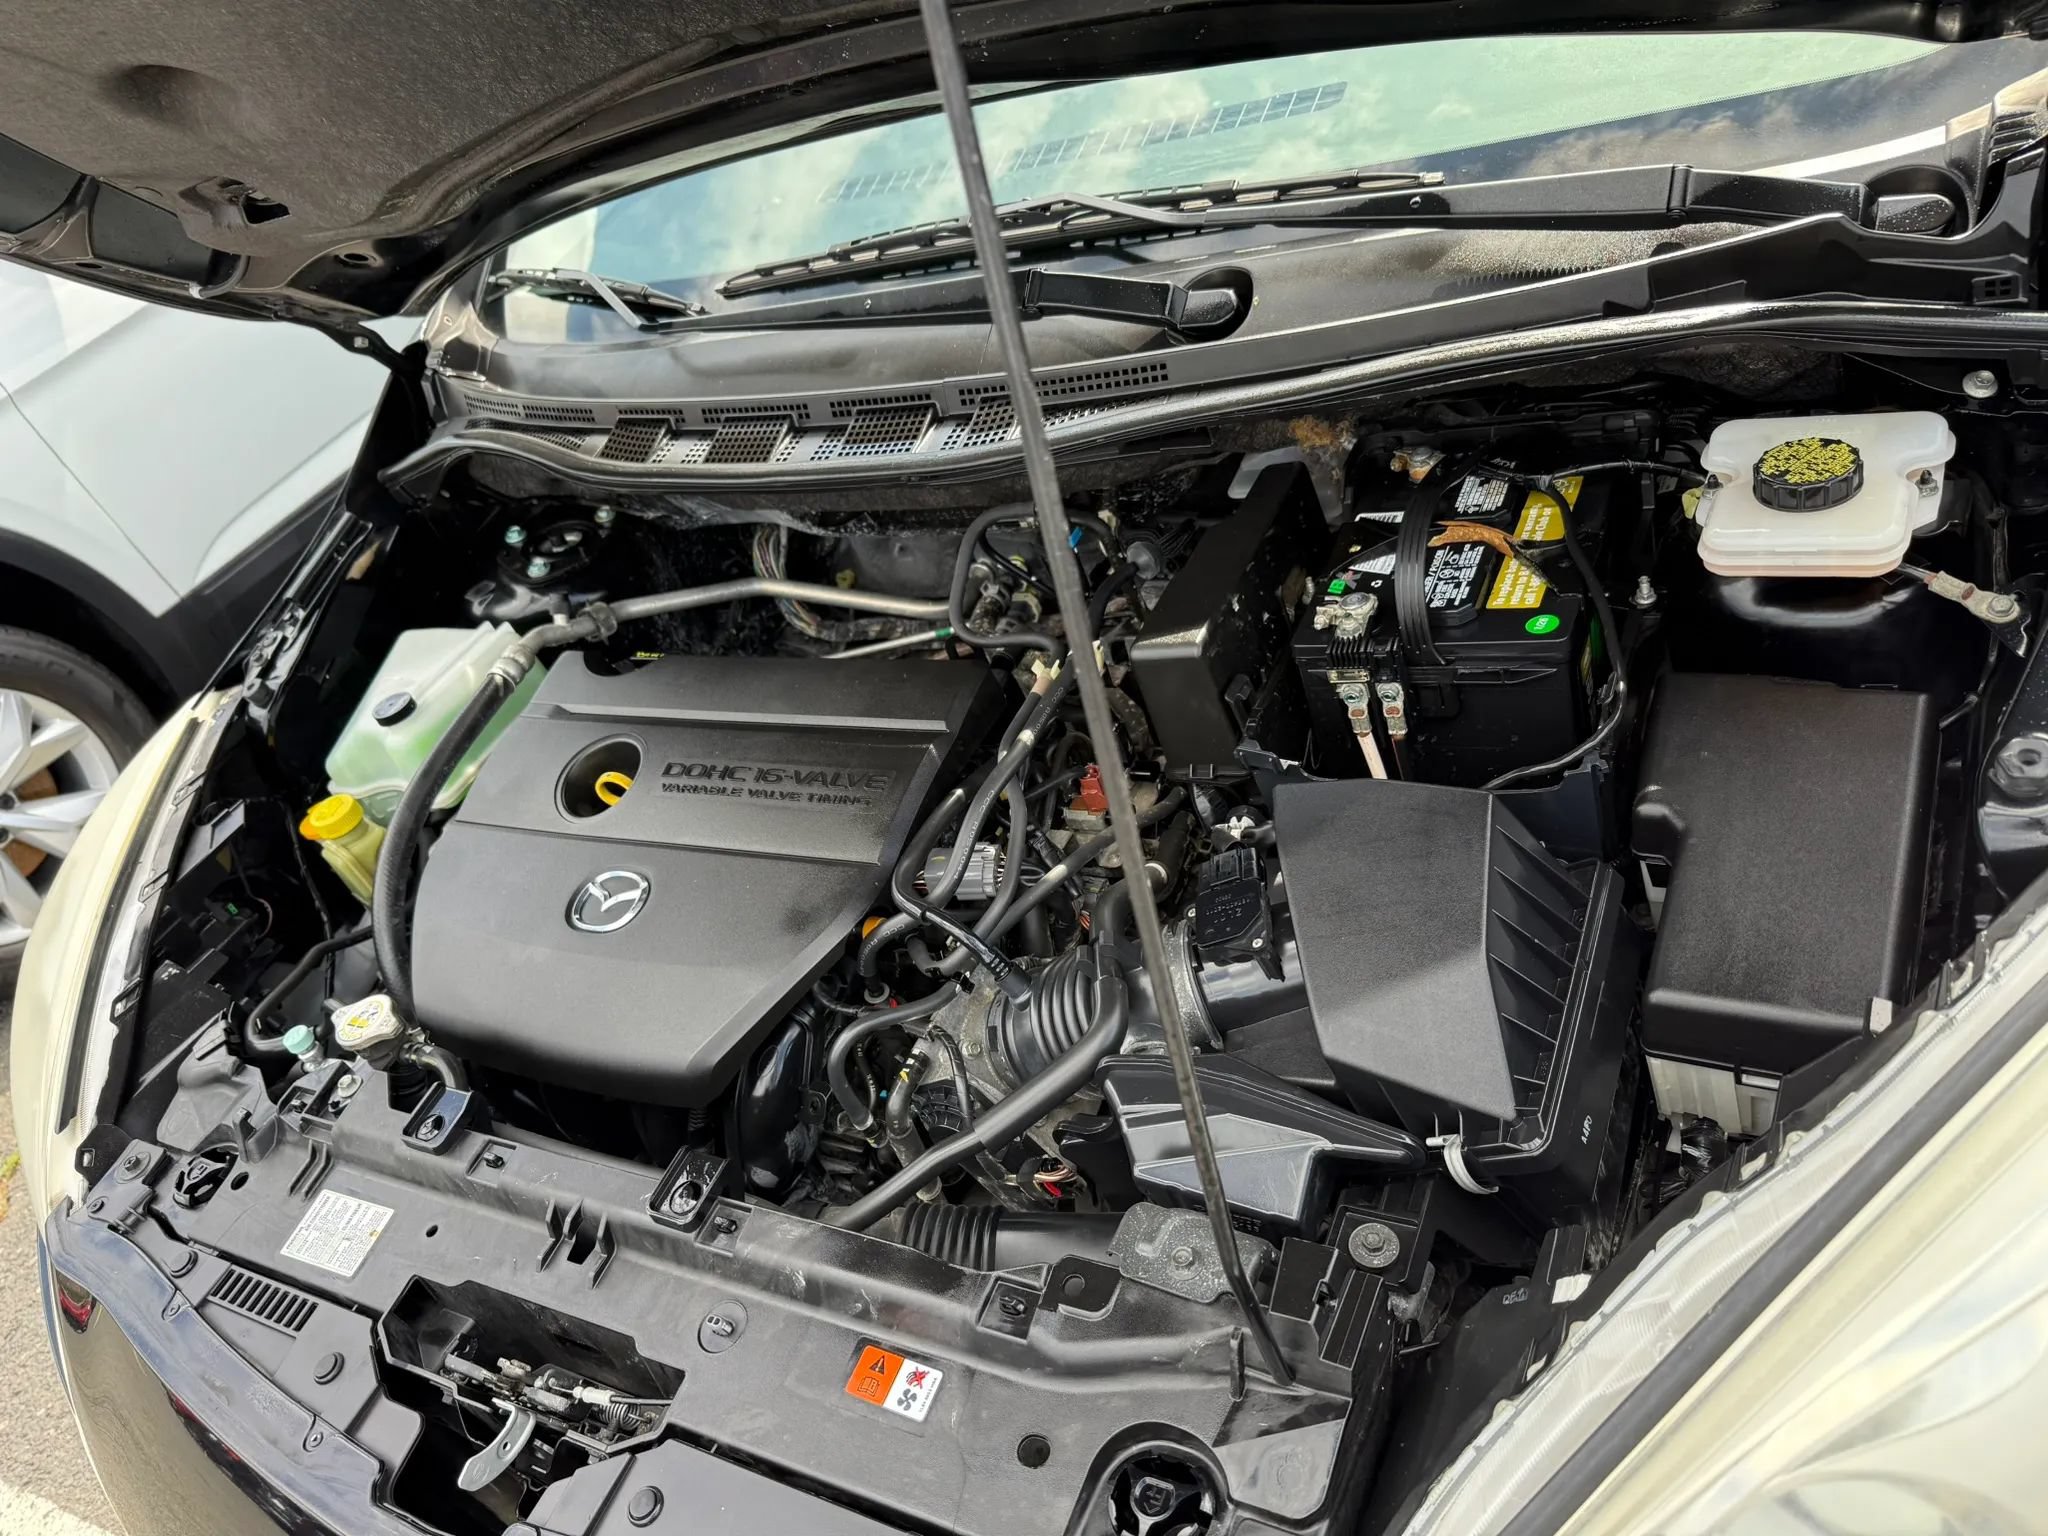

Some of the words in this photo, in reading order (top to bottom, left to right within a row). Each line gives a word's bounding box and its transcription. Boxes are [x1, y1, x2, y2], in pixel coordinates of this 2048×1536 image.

[661, 762, 752, 783] DOHC
[753, 767, 891, 791] 16-VALVE
[661, 783, 744, 797] VARIABLE
[748, 788, 802, 802] VALVE
[807, 792, 873, 806] TIMING
